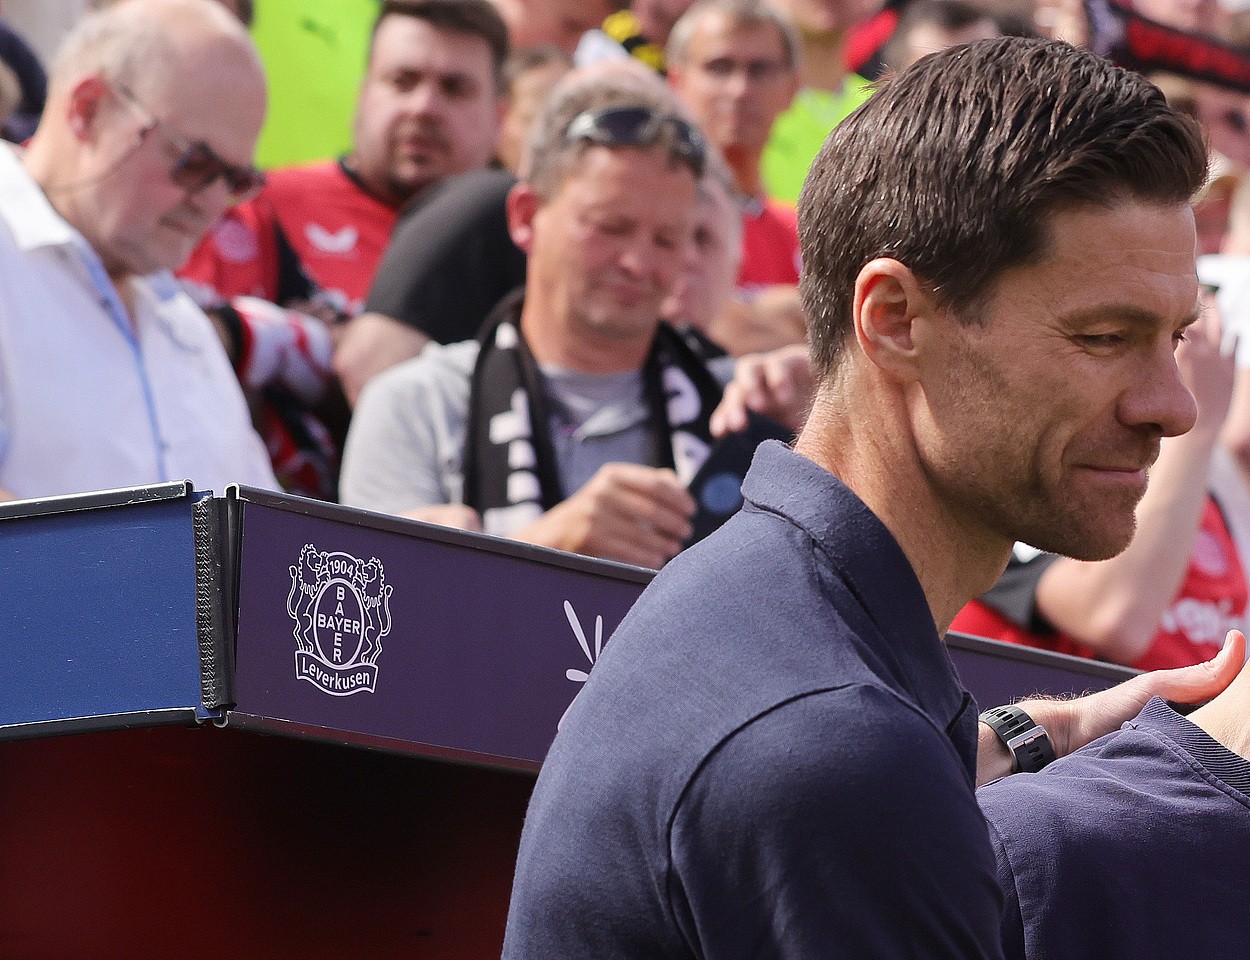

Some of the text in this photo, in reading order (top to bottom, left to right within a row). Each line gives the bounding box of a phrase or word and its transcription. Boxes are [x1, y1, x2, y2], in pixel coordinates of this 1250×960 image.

[329, 559, 355, 578] 1904
[317, 613, 361, 636] BAYER
[333, 586, 346, 663] BAYER
[301, 656, 371, 690] Leverkusen
